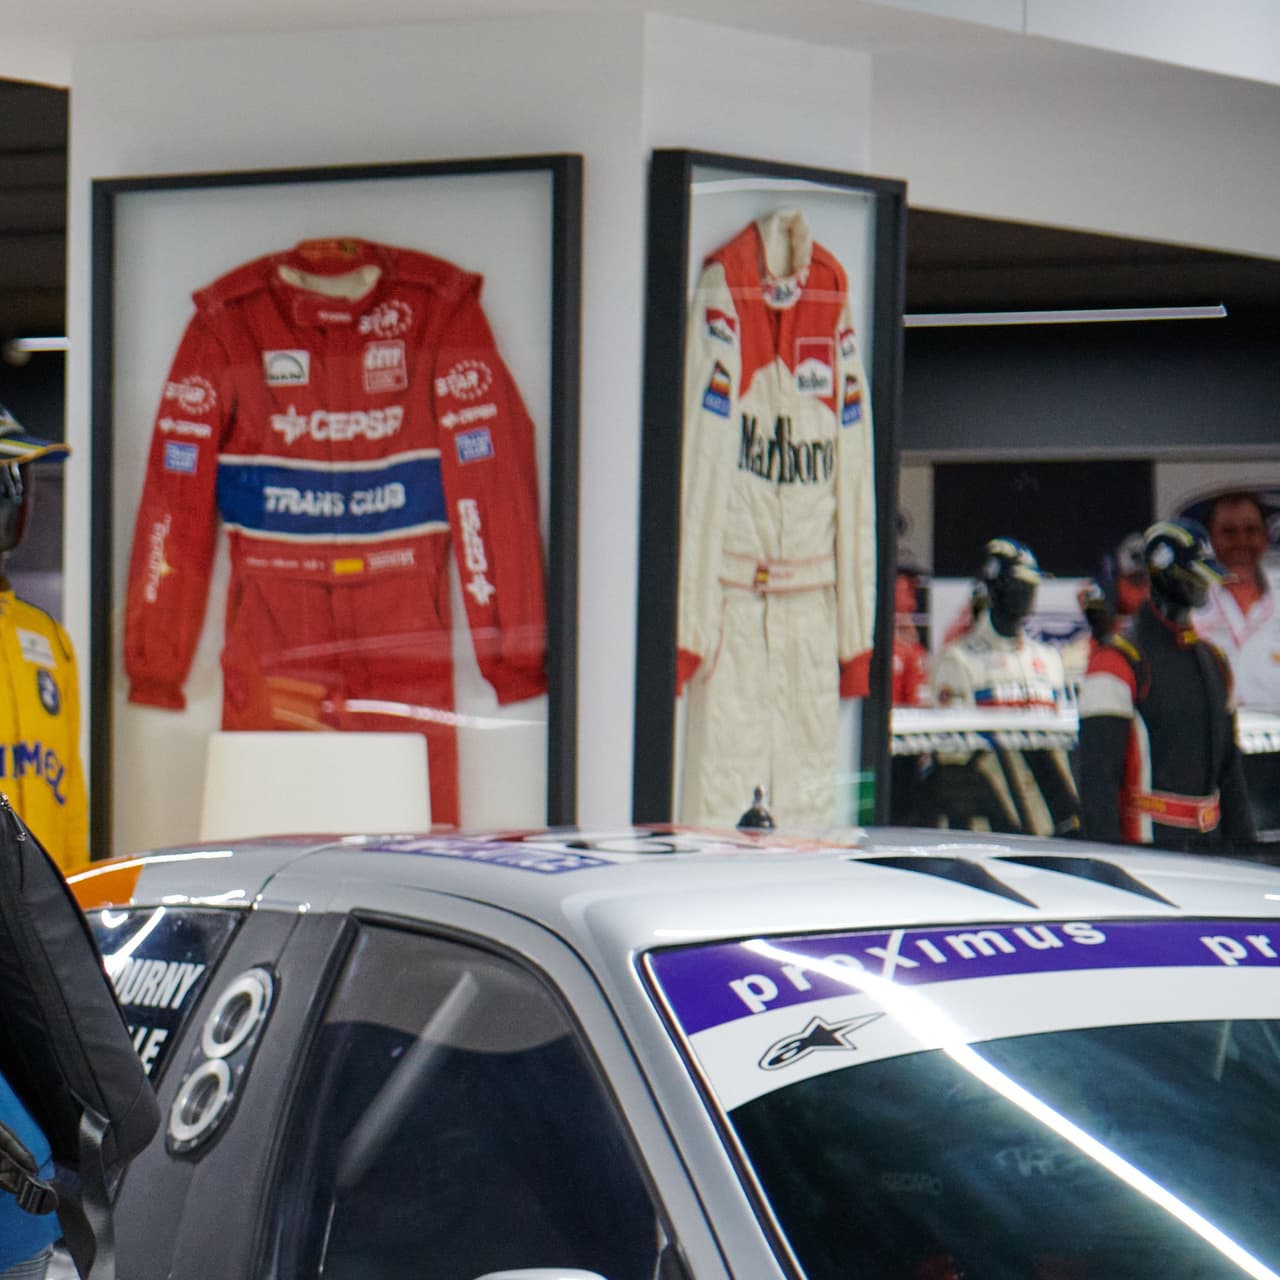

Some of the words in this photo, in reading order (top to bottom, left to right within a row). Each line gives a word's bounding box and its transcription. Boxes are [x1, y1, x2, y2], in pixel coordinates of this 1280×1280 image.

[738, 411, 835, 484] Marlboro
[263, 485, 345, 517] TRANS
[349, 482, 406, 516] CLUB
